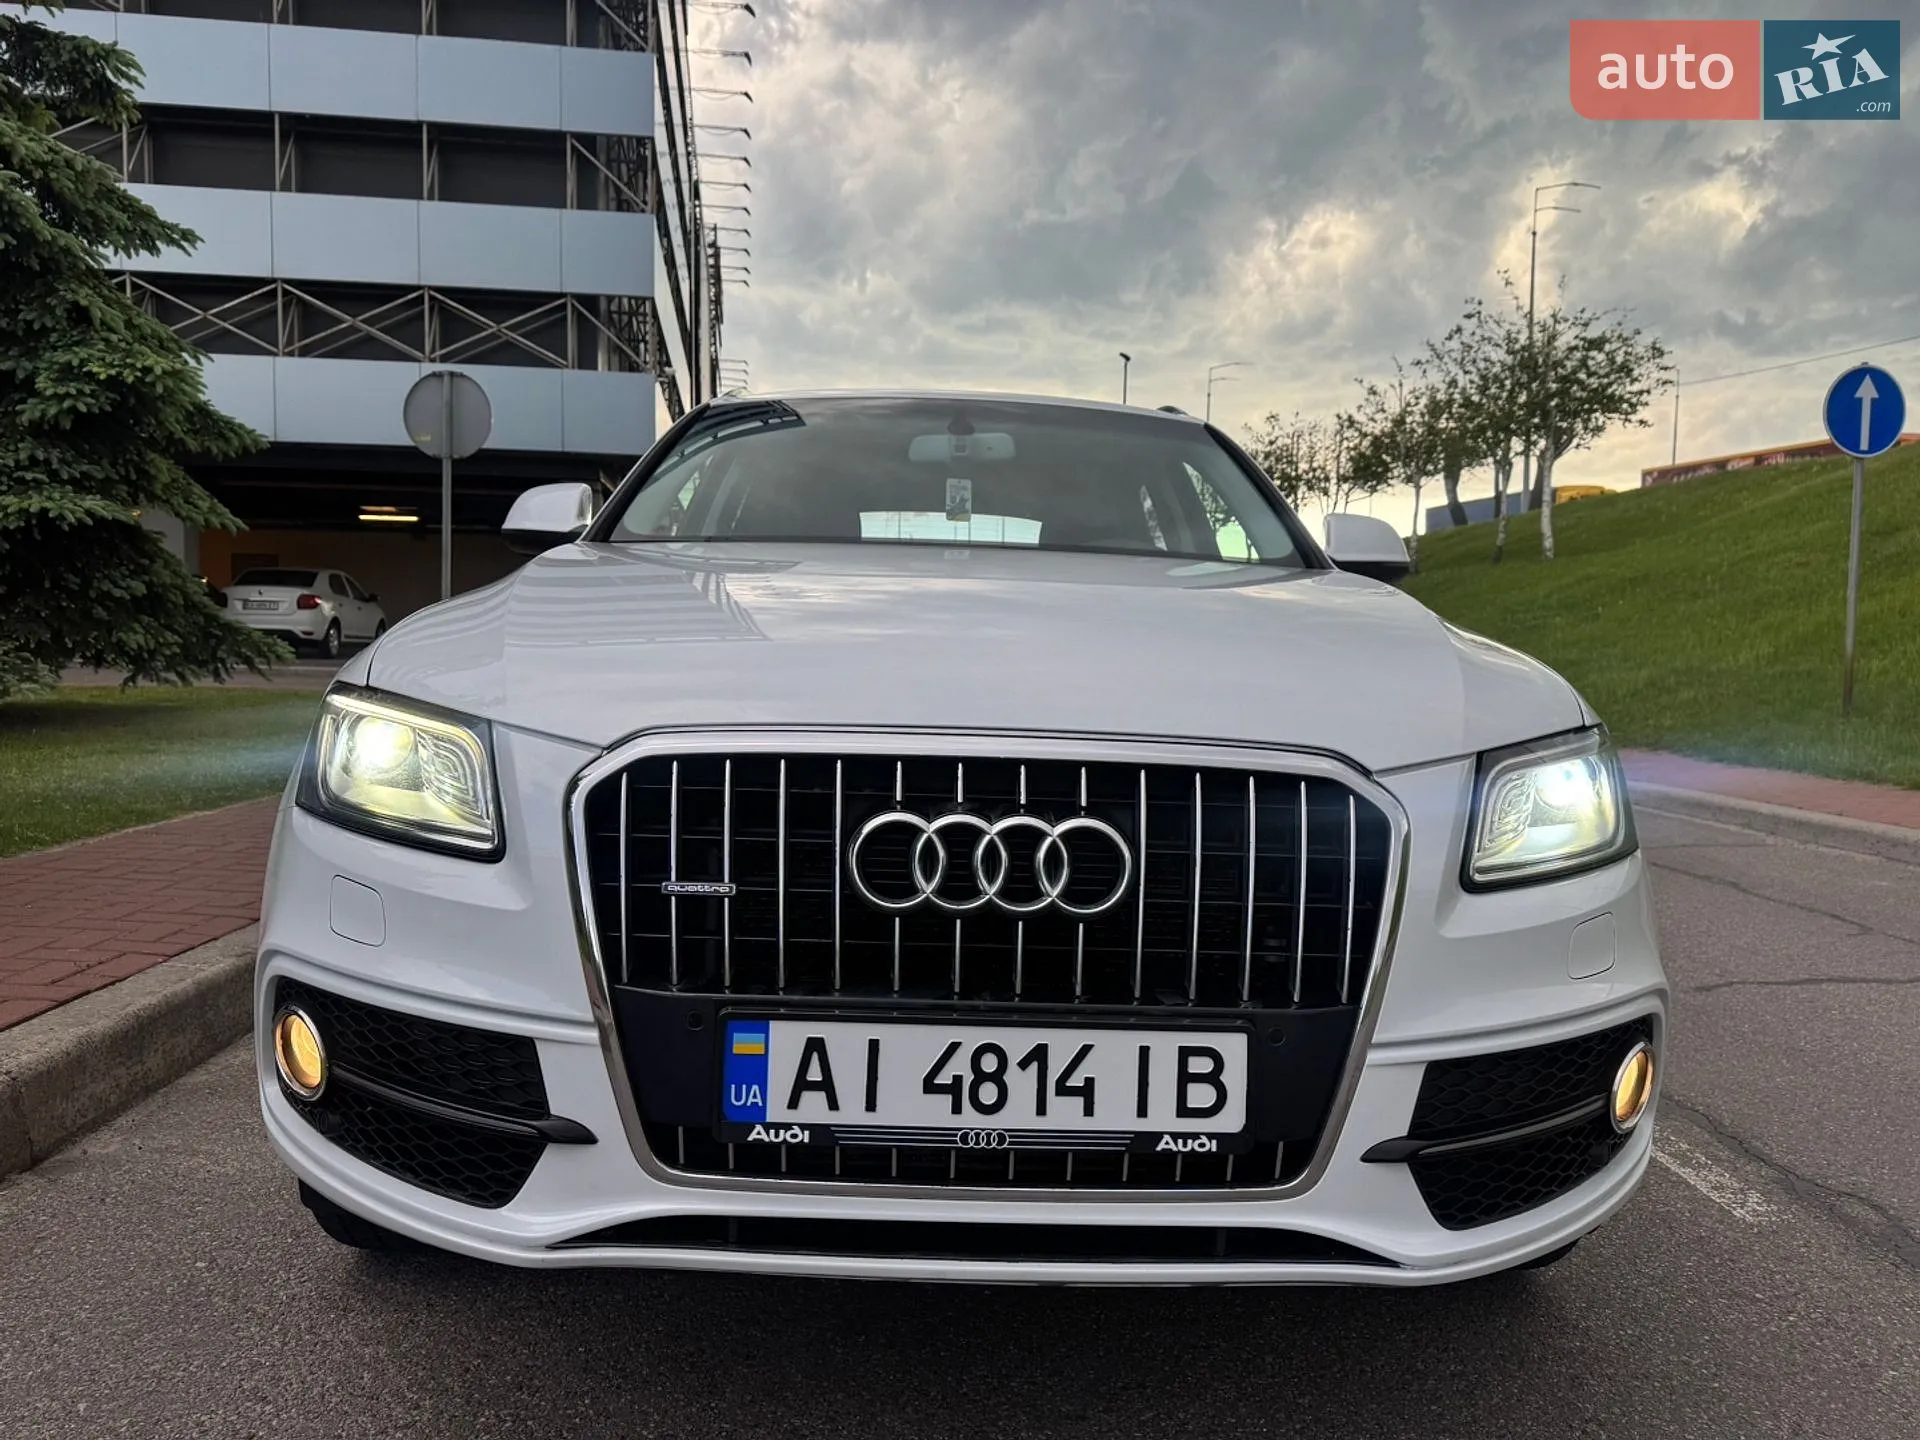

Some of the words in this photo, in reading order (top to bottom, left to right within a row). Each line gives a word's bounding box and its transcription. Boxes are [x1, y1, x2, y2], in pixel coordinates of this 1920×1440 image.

[667, 885, 730, 893] quattro
[786, 1035, 880, 1112] AI
[922, 1040, 1095, 1117] 4814
[1136, 1045, 1228, 1118] IB
[730, 1084, 763, 1106] UA
[746, 1124, 810, 1143] Audi
[1155, 1133, 1218, 1152] Audi
